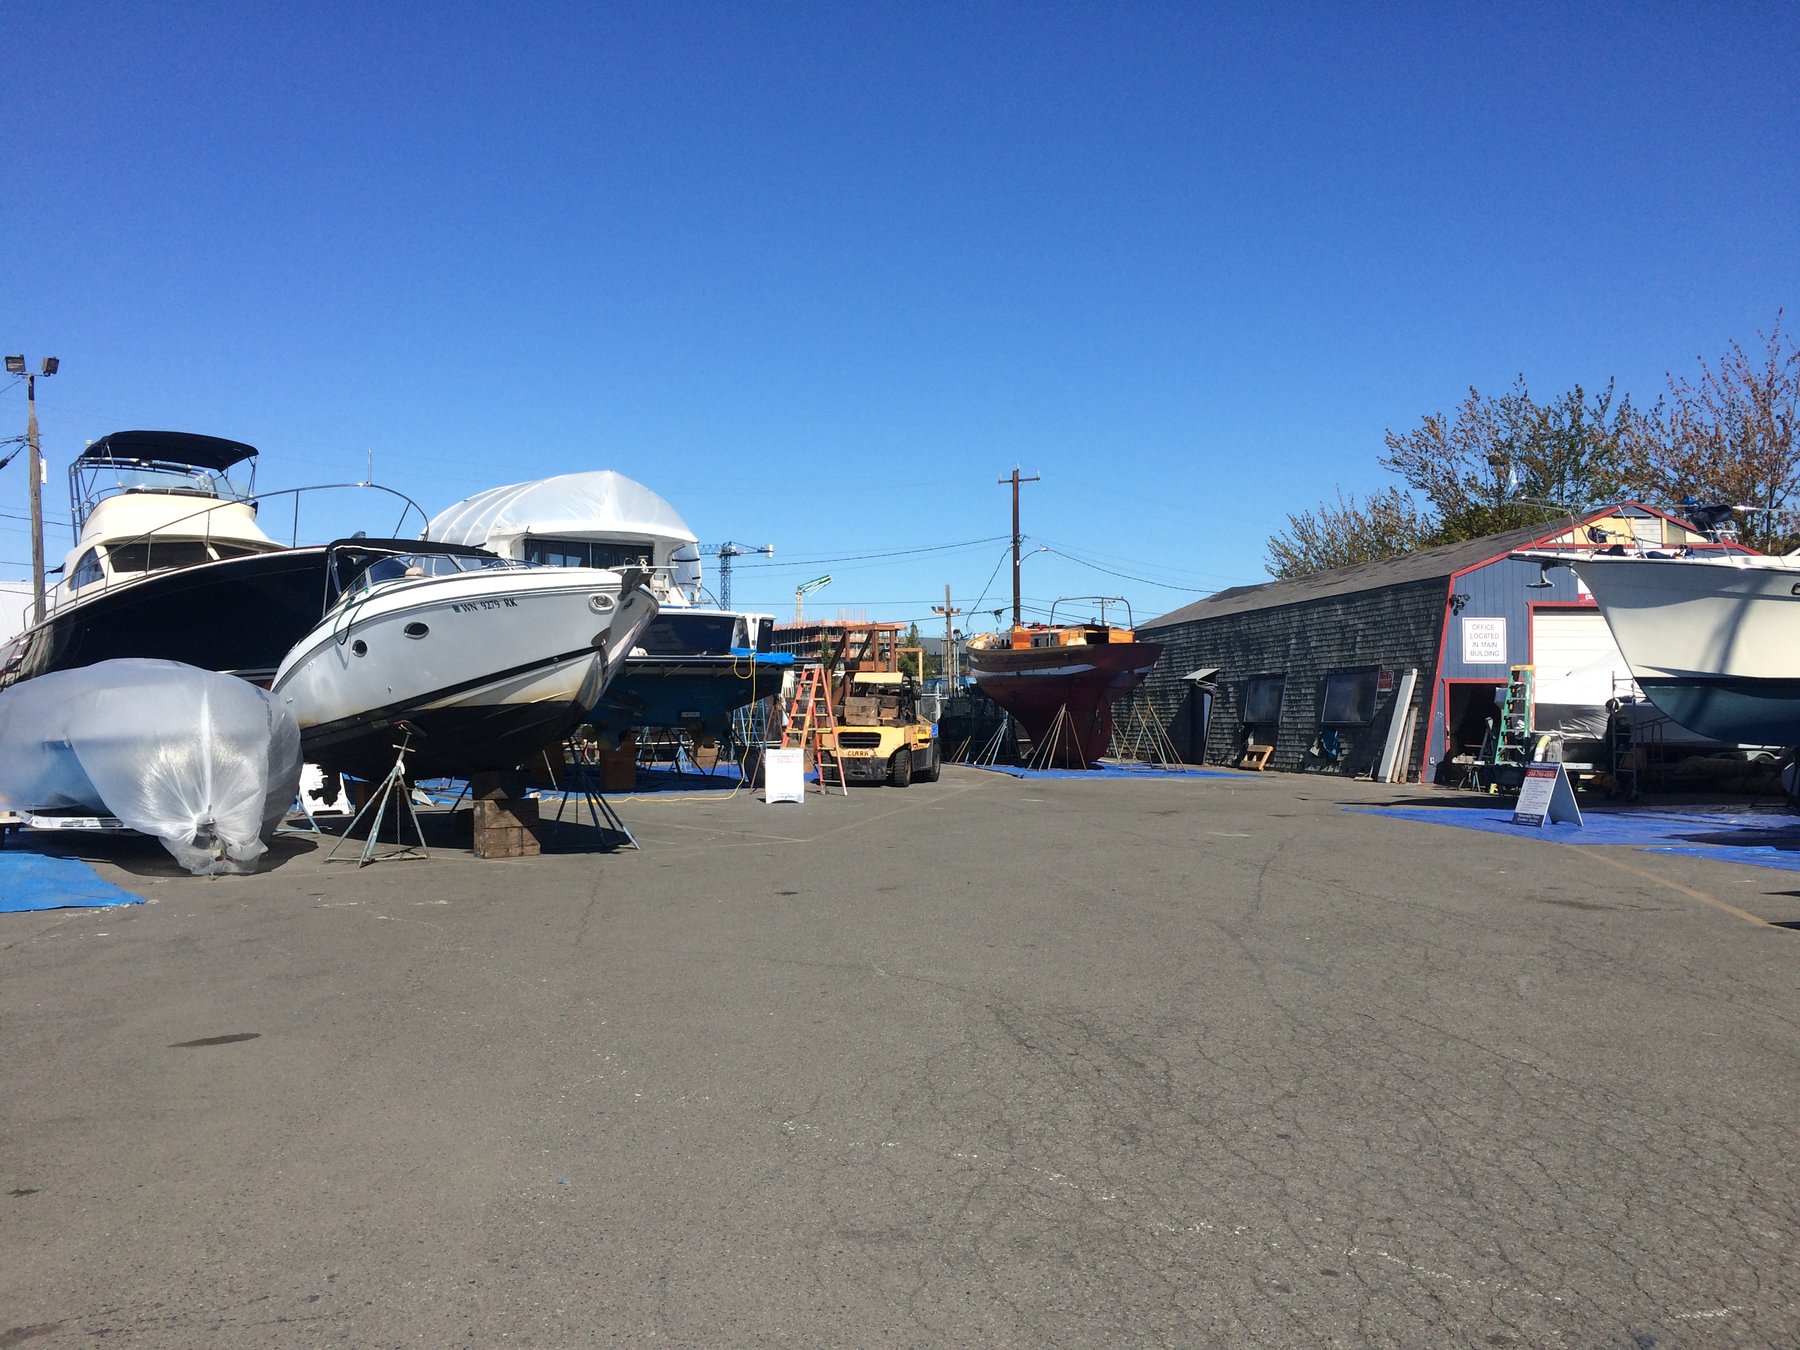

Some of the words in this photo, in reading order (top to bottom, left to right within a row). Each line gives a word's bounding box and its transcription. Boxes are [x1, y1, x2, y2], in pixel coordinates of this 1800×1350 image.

[460, 602, 479, 613] WN
[480, 599, 501, 610] 9279
[503, 597, 518, 608] RK
[1471, 623, 1495, 631] OFFICE
[1469, 632, 1500, 640] LOCATED
